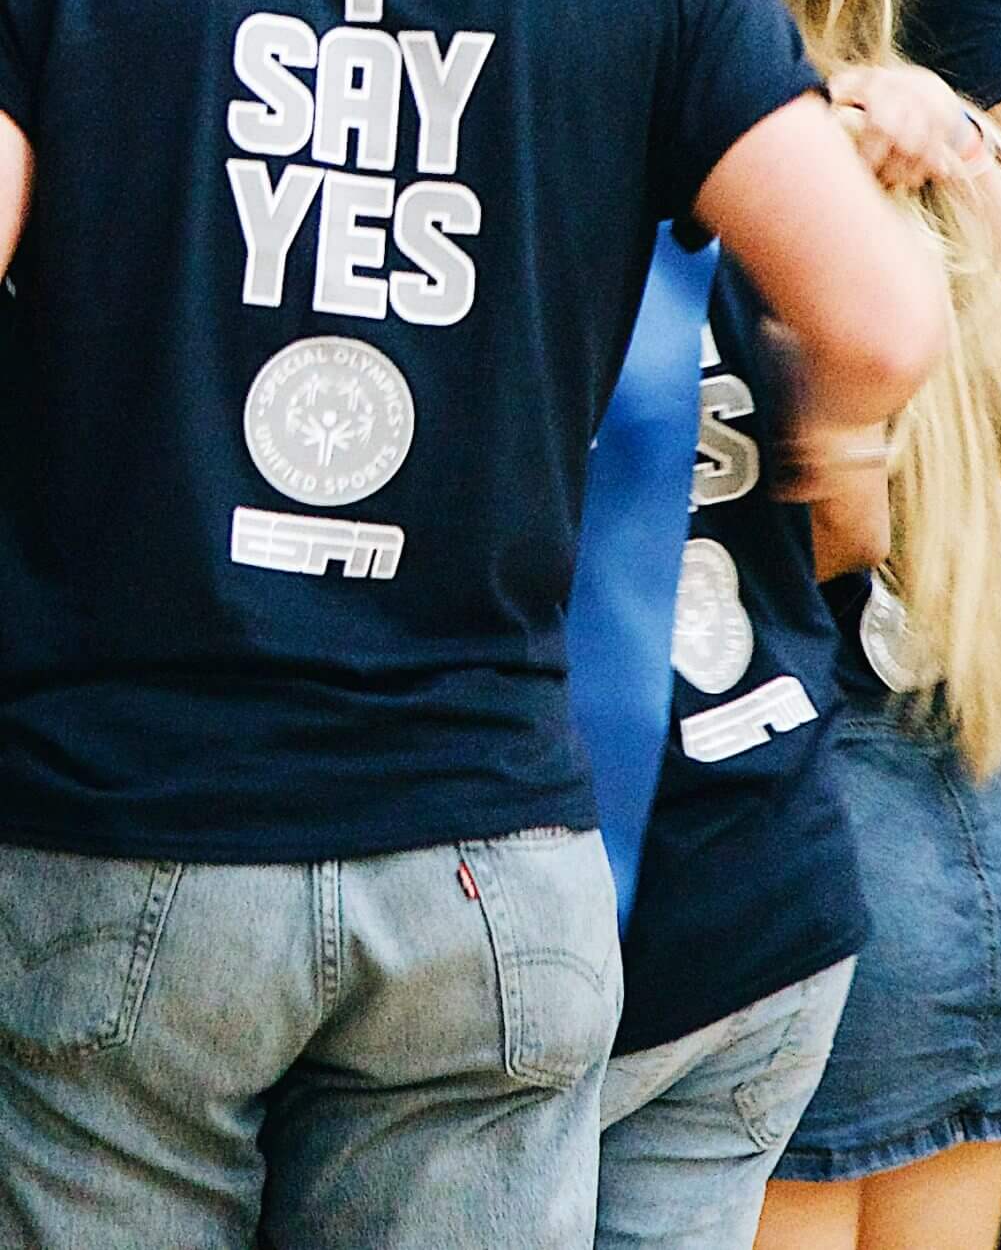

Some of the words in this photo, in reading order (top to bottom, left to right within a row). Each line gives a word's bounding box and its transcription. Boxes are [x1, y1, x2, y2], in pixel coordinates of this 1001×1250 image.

[226, 12, 496, 175] SAY
[225, 157, 482, 326] YES
[258, 347, 329, 408] SPECIAL
[333, 350, 405, 427] OLYMPICS
[255, 425, 318, 492] UNIFIED
[324, 446, 398, 496] SPORTS
[231, 506, 405, 579] ESPN
